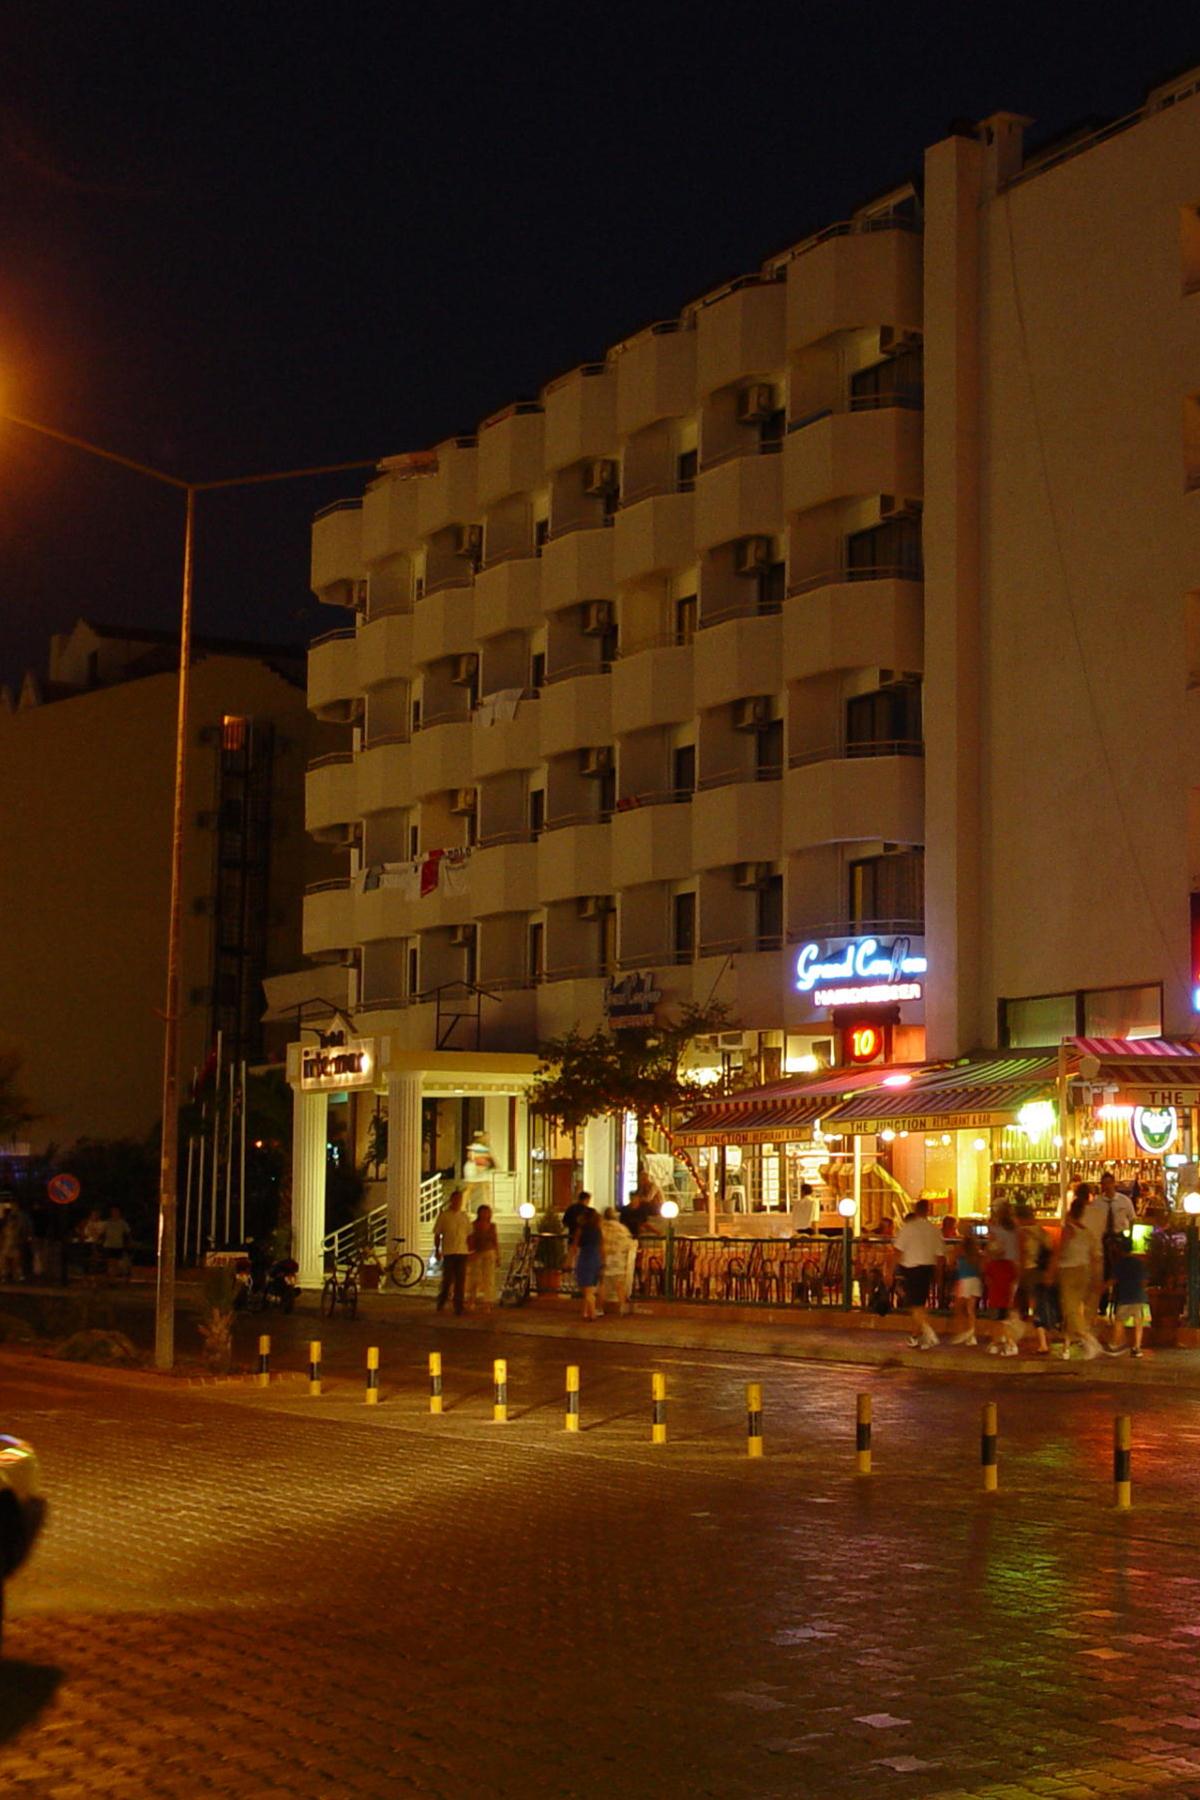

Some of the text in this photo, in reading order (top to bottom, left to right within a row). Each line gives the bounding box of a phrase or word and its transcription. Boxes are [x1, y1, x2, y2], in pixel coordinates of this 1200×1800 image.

[852, 1028, 876, 1057] 10
[1149, 1091, 1184, 1105] THE
[850, 1121, 868, 1133] THE
[874, 1118, 927, 1132] JUNCTION
[683, 1134, 699, 1146] THE
[705, 1132, 749, 1146] JUNCTION
